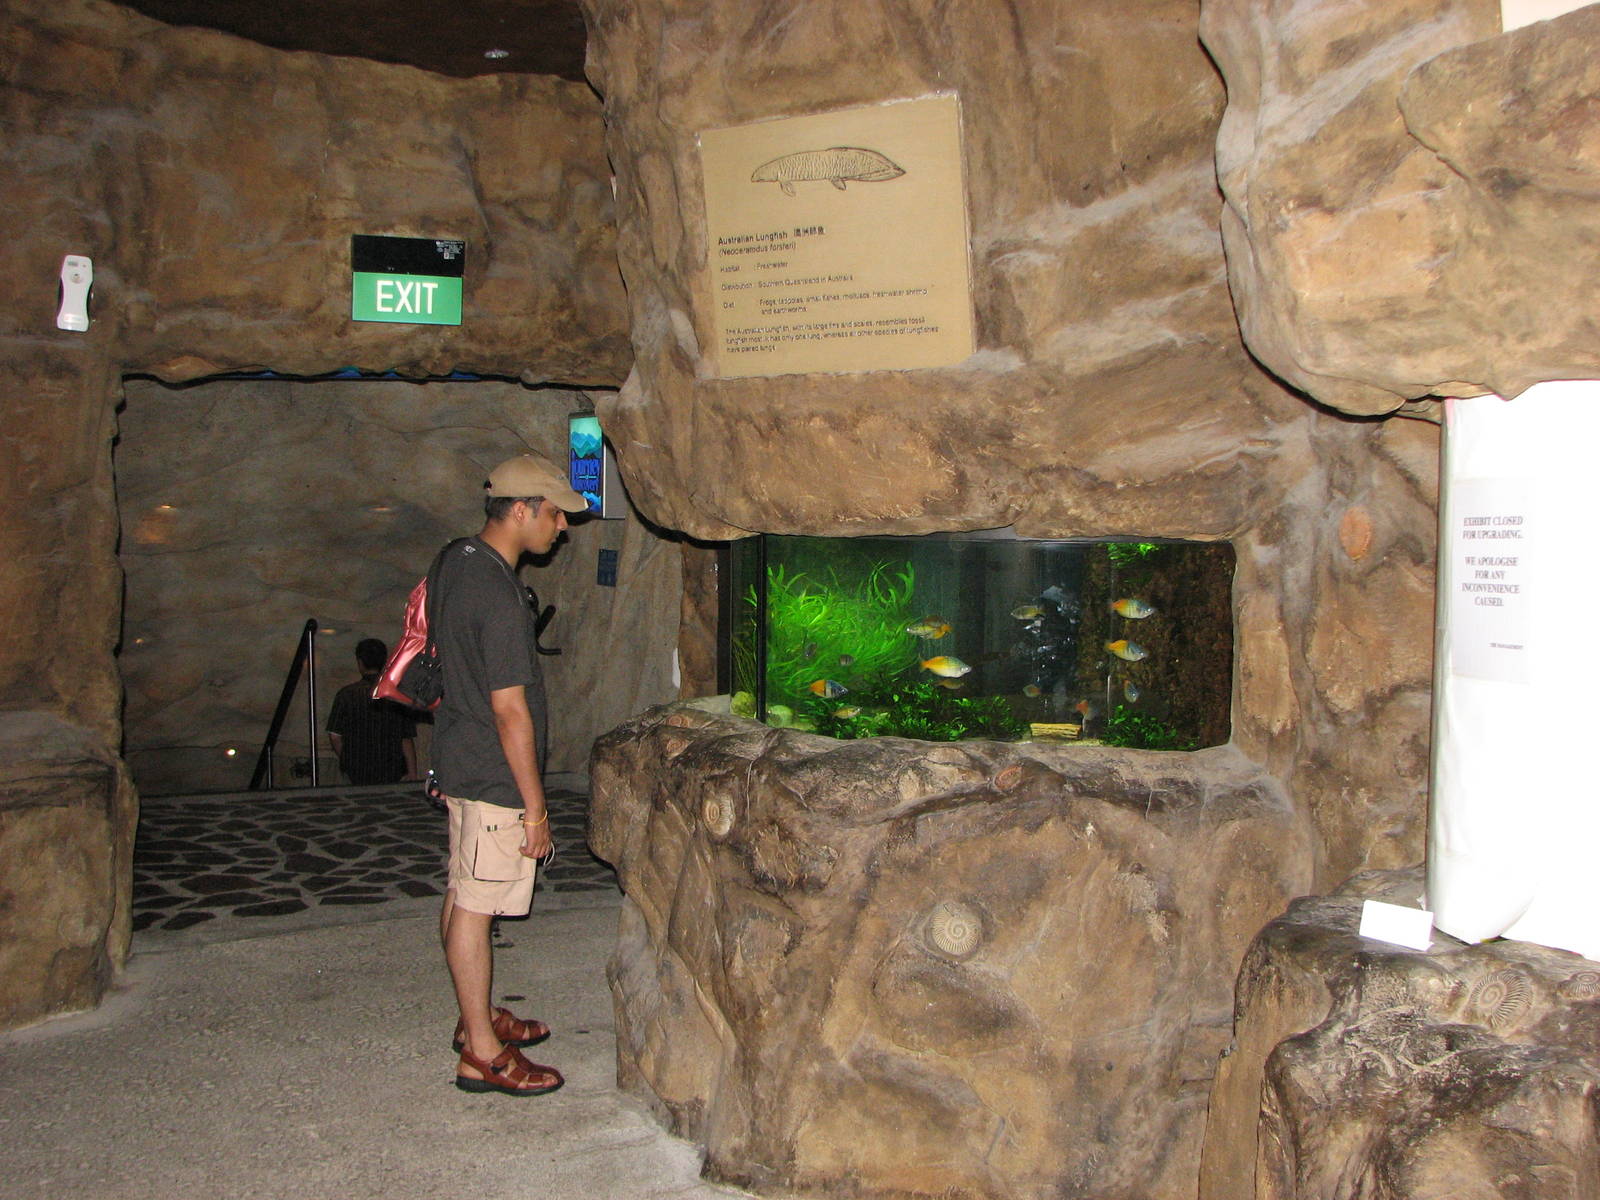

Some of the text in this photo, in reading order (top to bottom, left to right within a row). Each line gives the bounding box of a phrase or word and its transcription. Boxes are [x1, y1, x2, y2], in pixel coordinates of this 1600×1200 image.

[719, 231, 788, 245] Australian Lungfish
[376, 280, 438, 314] EXIT
[1463, 516, 1523, 526] EXHIBIT CLOSED
[1463, 530, 1476, 539] FOR
[1465, 556, 1519, 566] WE APOLOGISE
[1475, 570, 1505, 580] FOR ANY
[1462, 583, 1520, 594] INCONVENIENCE
